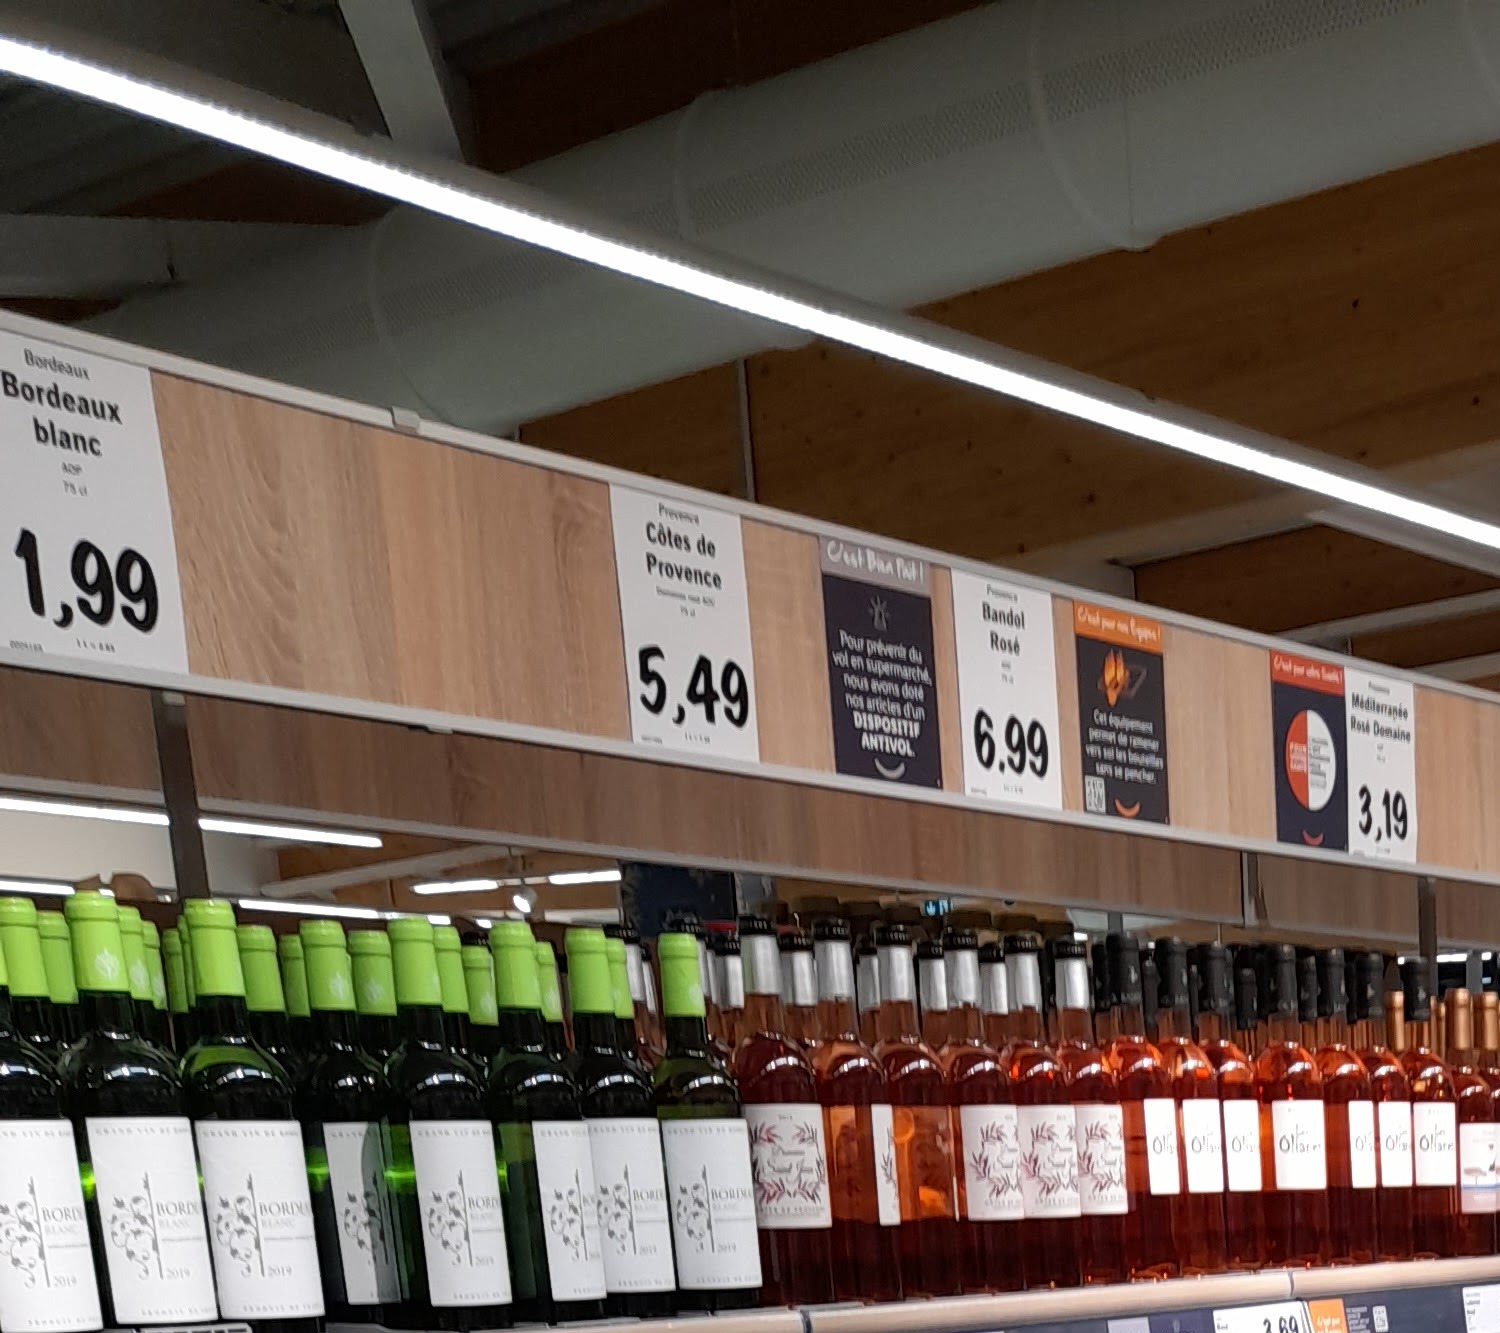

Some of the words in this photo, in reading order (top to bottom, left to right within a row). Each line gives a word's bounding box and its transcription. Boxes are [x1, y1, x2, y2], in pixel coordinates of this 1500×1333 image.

[24, 348, 90, 381] Bordeaux
[0, 369, 123, 426] Bordeaux
[33, 415, 103, 457] blanc
[645, 520, 691, 553] Côtes
[697, 532, 717, 559] de
[827, 540, 862, 570] C'est
[14, 527, 159, 635] 1,99
[645, 551, 722, 590] Provence
[982, 600, 1025, 631] Bandol
[839, 629, 864, 651] Pour
[908, 645, 922, 665] du
[989, 629, 1021, 658] Rosé
[832, 650, 849, 669] vol
[851, 657, 864, 672] en
[638, 643, 749, 729] 5,49
[843, 672, 869, 693] nous
[853, 711, 921, 739] DISPOSITIF
[1350, 715, 1370, 735] Rosé
[1373, 720, 1411, 745] Domaine
[1358, 783, 1408, 843] 3,19
[166, 1267, 191, 1280] 2019
